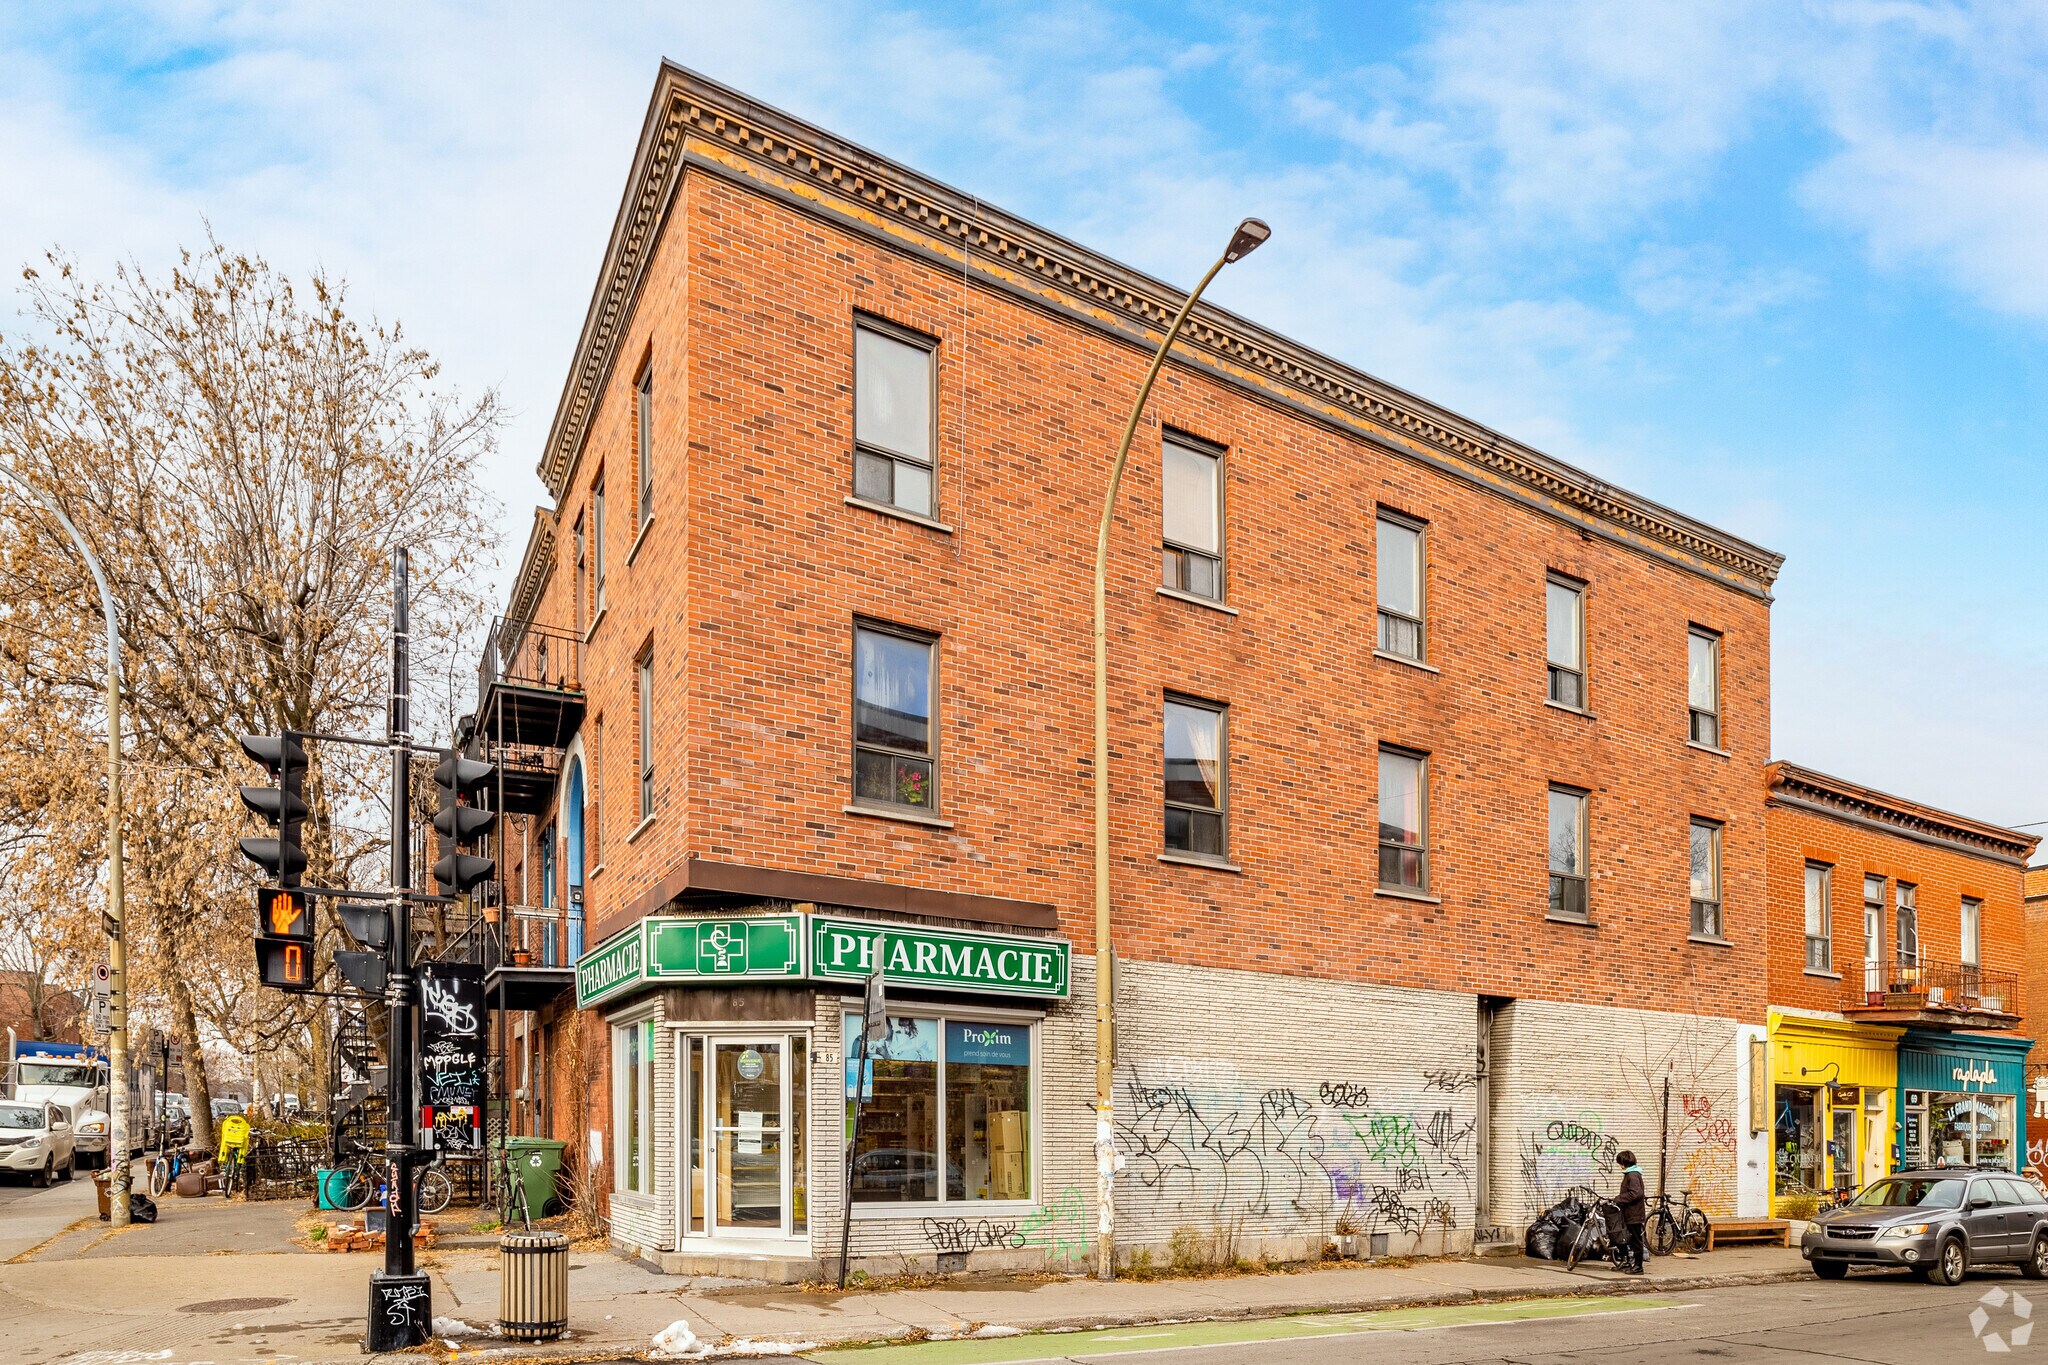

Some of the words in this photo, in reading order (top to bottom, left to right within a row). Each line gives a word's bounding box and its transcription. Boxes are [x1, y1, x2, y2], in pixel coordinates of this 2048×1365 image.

[830, 933, 1053, 984] PHARMACIE
[581, 939, 640, 997] PHARMACIE
[99, 1001, 106, 1013] P
[732, 998, 745, 1007] 85
[825, 1053, 834, 1063] 85
[963, 1050, 979, 1058] prend
[1947, 1106, 1956, 1122] LE
